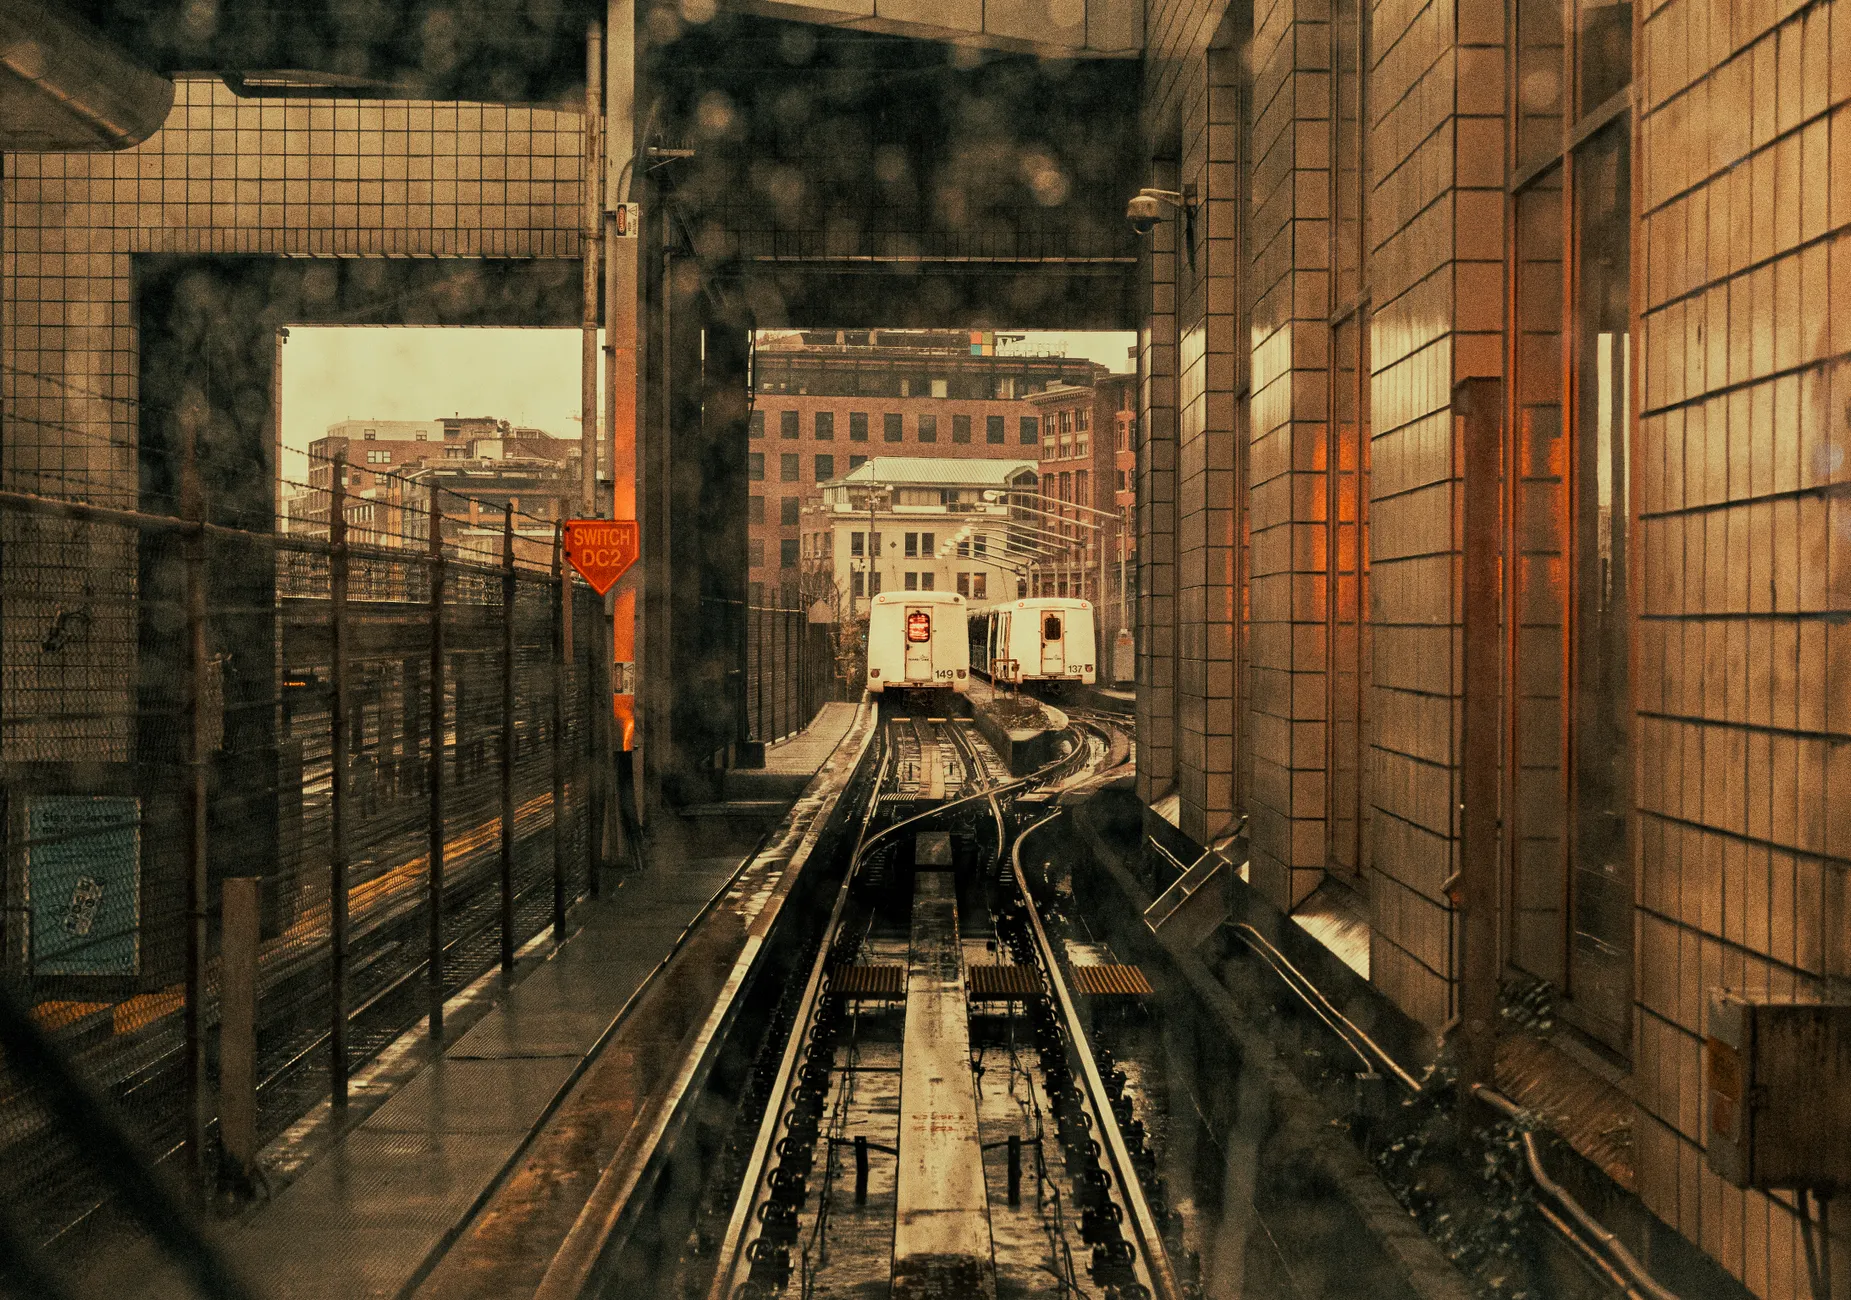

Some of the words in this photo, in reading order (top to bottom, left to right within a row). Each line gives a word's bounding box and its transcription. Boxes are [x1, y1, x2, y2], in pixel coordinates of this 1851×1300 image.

[574, 528, 630, 546] SWITCH
[582, 549, 621, 567] DC2
[935, 669, 954, 679] 149
[1068, 665, 1083, 674] 137
